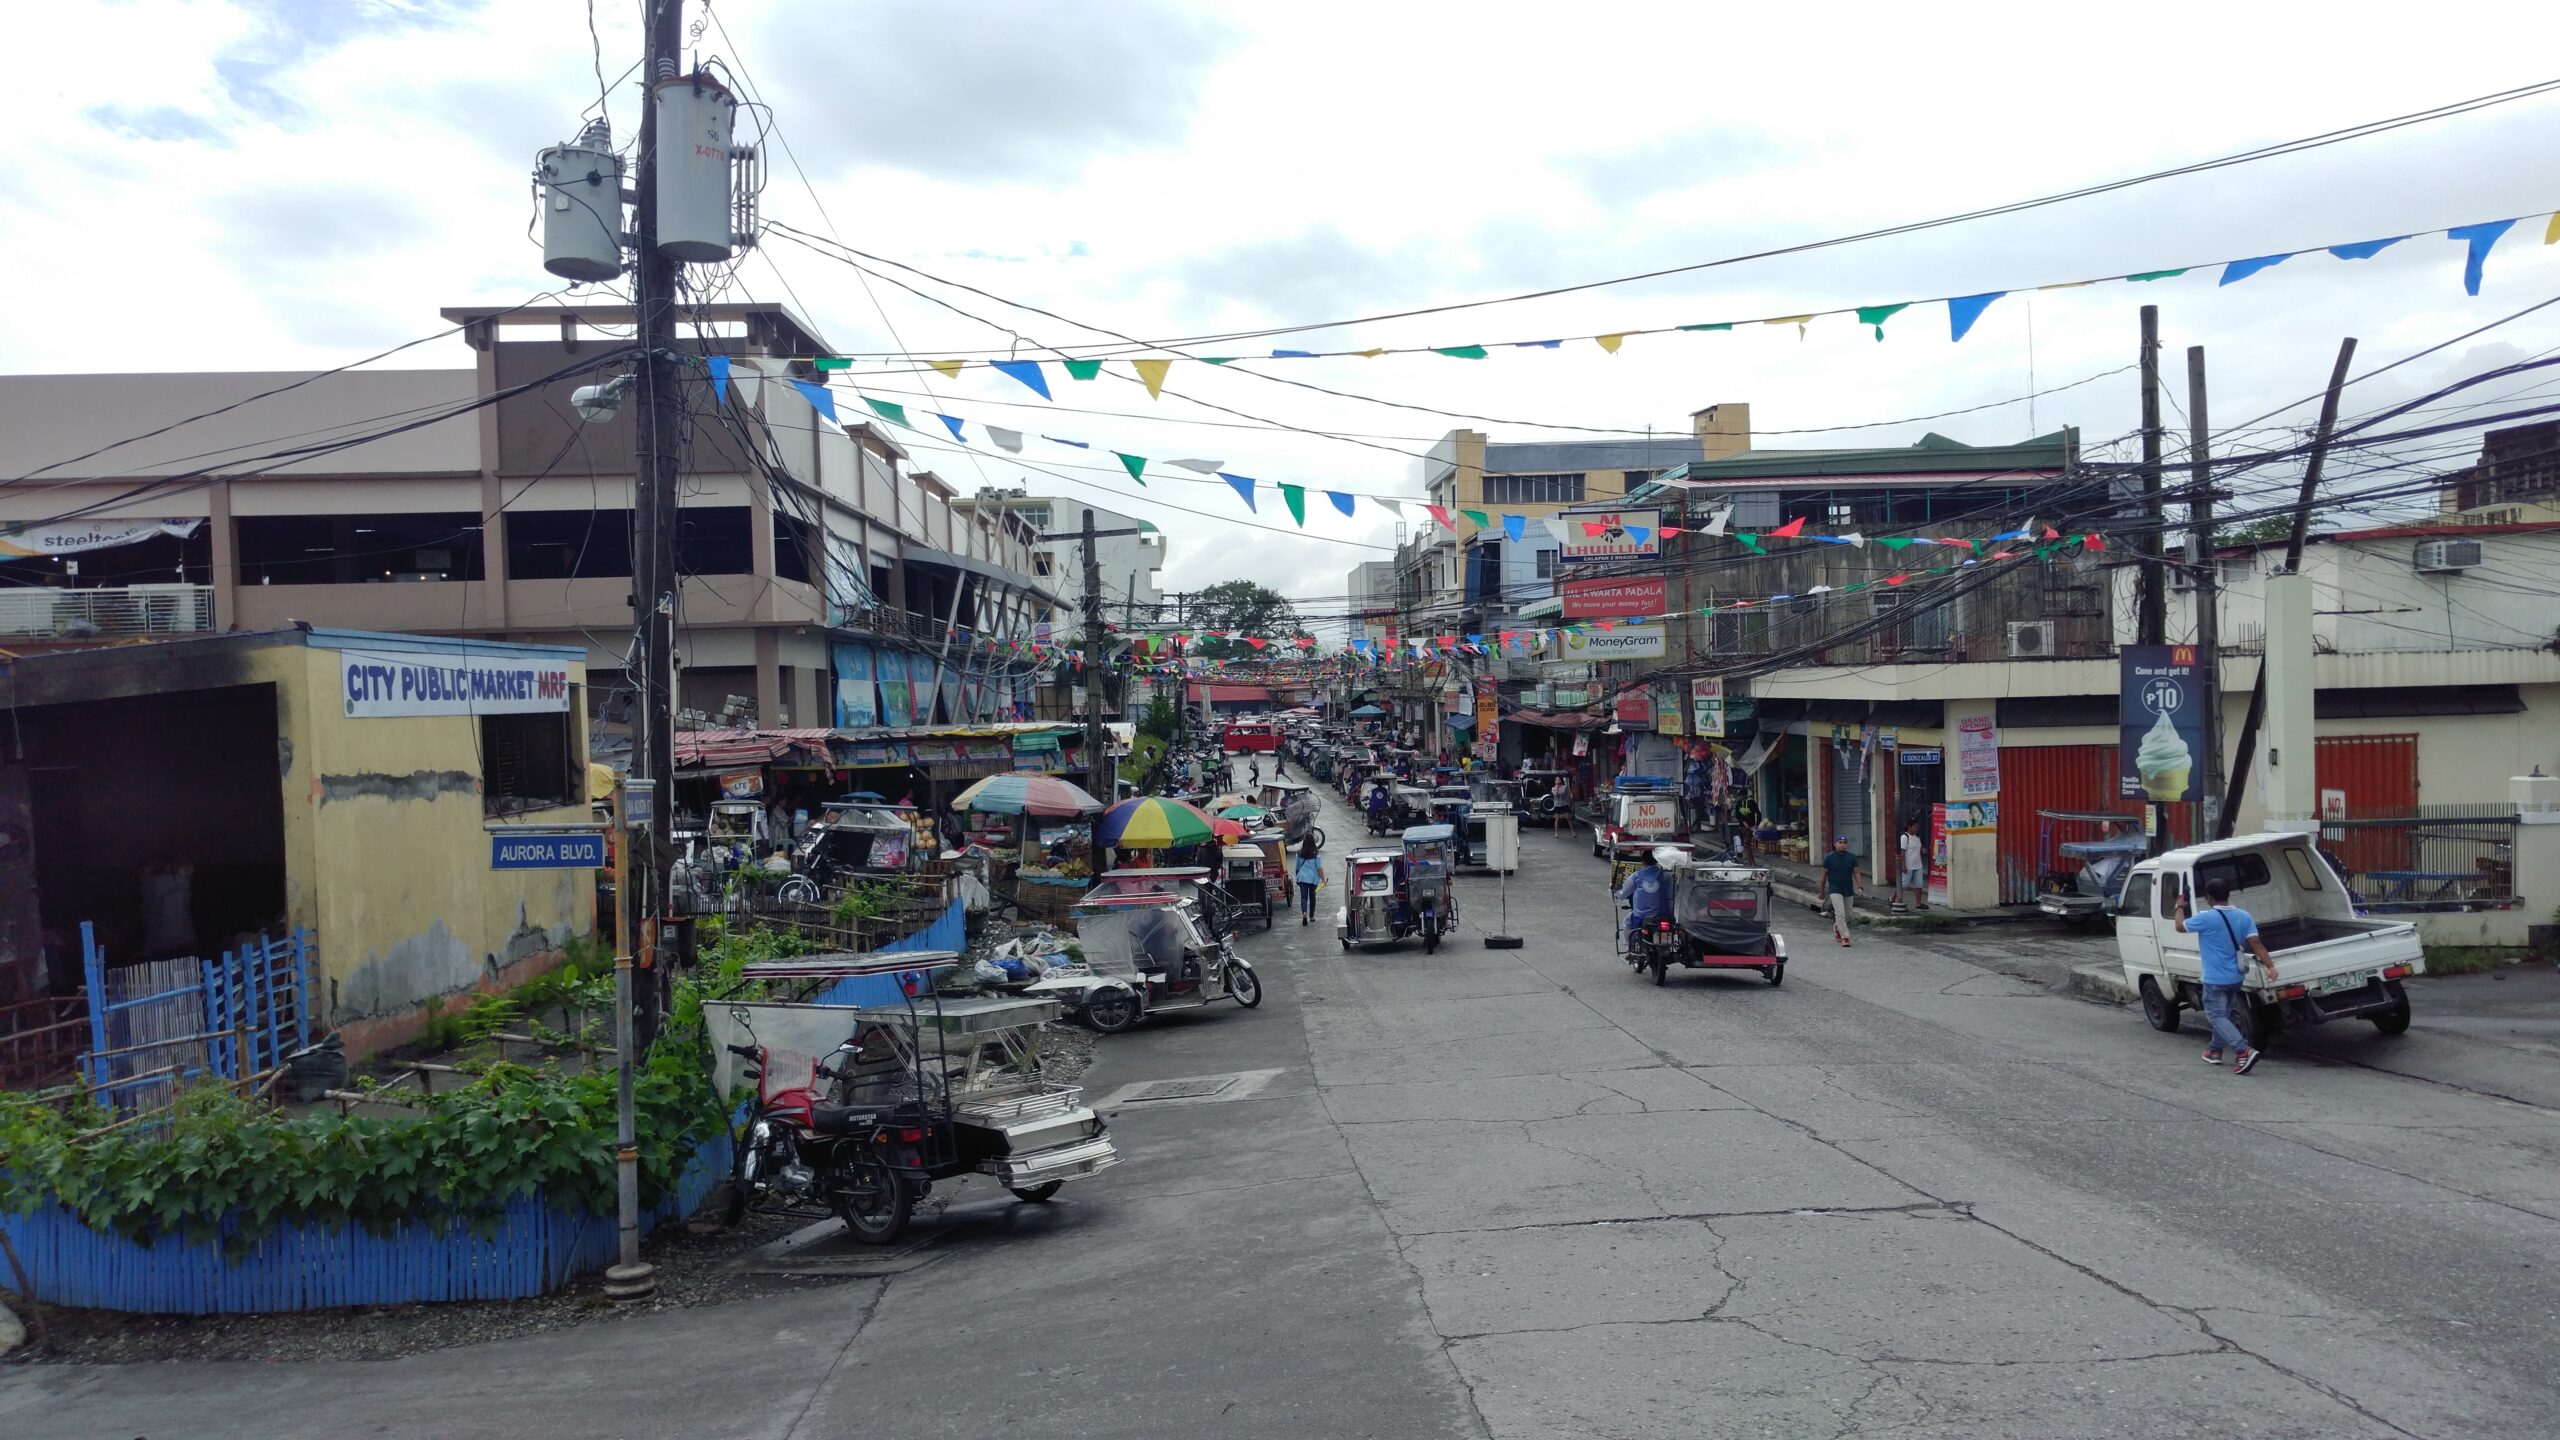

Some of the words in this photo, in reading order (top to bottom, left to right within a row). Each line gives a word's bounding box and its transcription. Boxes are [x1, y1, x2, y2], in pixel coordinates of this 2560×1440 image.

[1567, 543, 1655, 556] LHUILLIER
[1583, 587, 1623, 598] KWARTA
[1625, 586, 1663, 597] PADALA
[1602, 601, 1616, 610] your
[1618, 600, 1640, 608] money
[1589, 636, 1658, 648] MoneyGram
[1612, 648, 1638, 656] transfer
[2135, 667, 2153, 675] Cone
[2154, 667, 2167, 675] and
[2168, 667, 2180, 677] get
[2181, 667, 2190, 675] it!
[348, 664, 395, 701] CITY
[401, 667, 467, 701] PUBLIC
[471, 668, 534, 700] MARKET
[538, 670, 566, 699] MRF
[1959, 721, 1993, 730] OPENING
[1960, 716, 1990, 725] GRAND
[1639, 804, 1656, 816] NO
[1631, 817, 1671, 830] PARKING
[500, 845, 556, 861] AURORA
[560, 844, 596, 860] BLVD.
